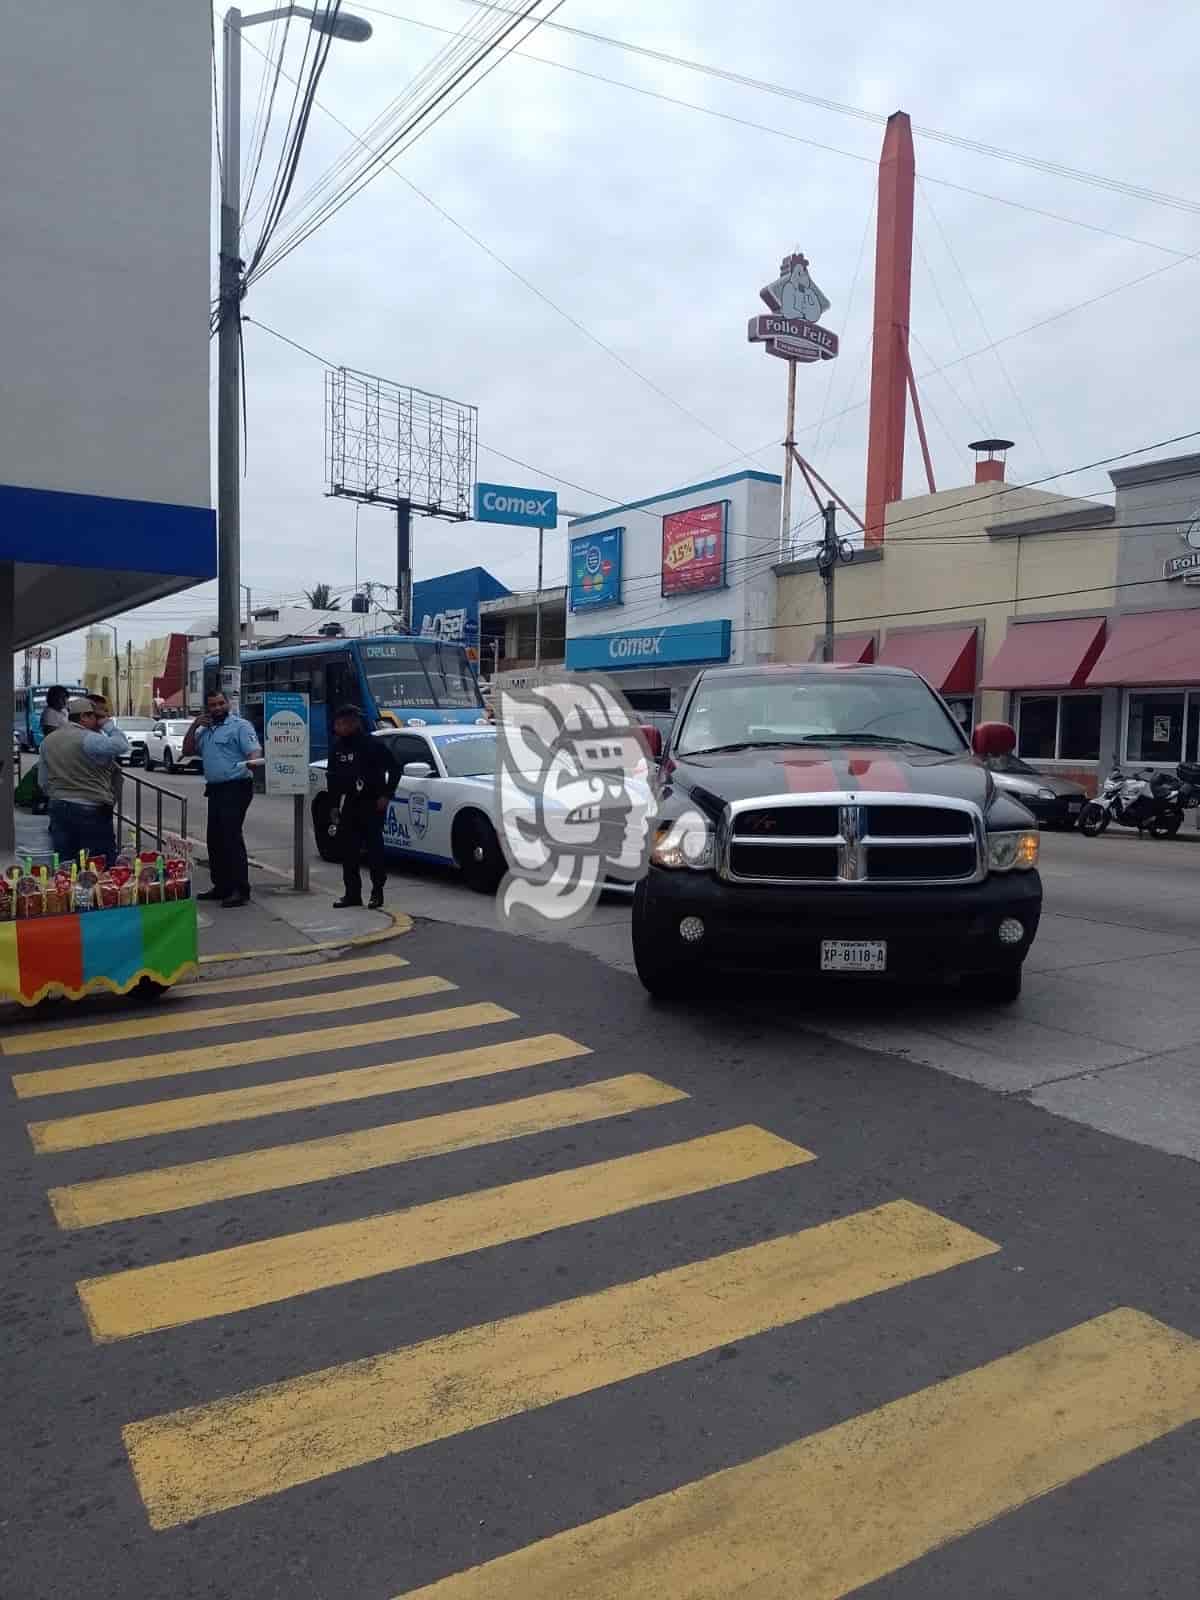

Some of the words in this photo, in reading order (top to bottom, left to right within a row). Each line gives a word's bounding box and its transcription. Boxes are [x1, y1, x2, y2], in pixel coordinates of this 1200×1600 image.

[766, 319, 798, 335] Pollo
[483, 492, 553, 516] Comex
[609, 628, 667, 658] Comex
[274, 735, 300, 745] NETFLIX
[824, 949, 883, 961] XP-8118-A
